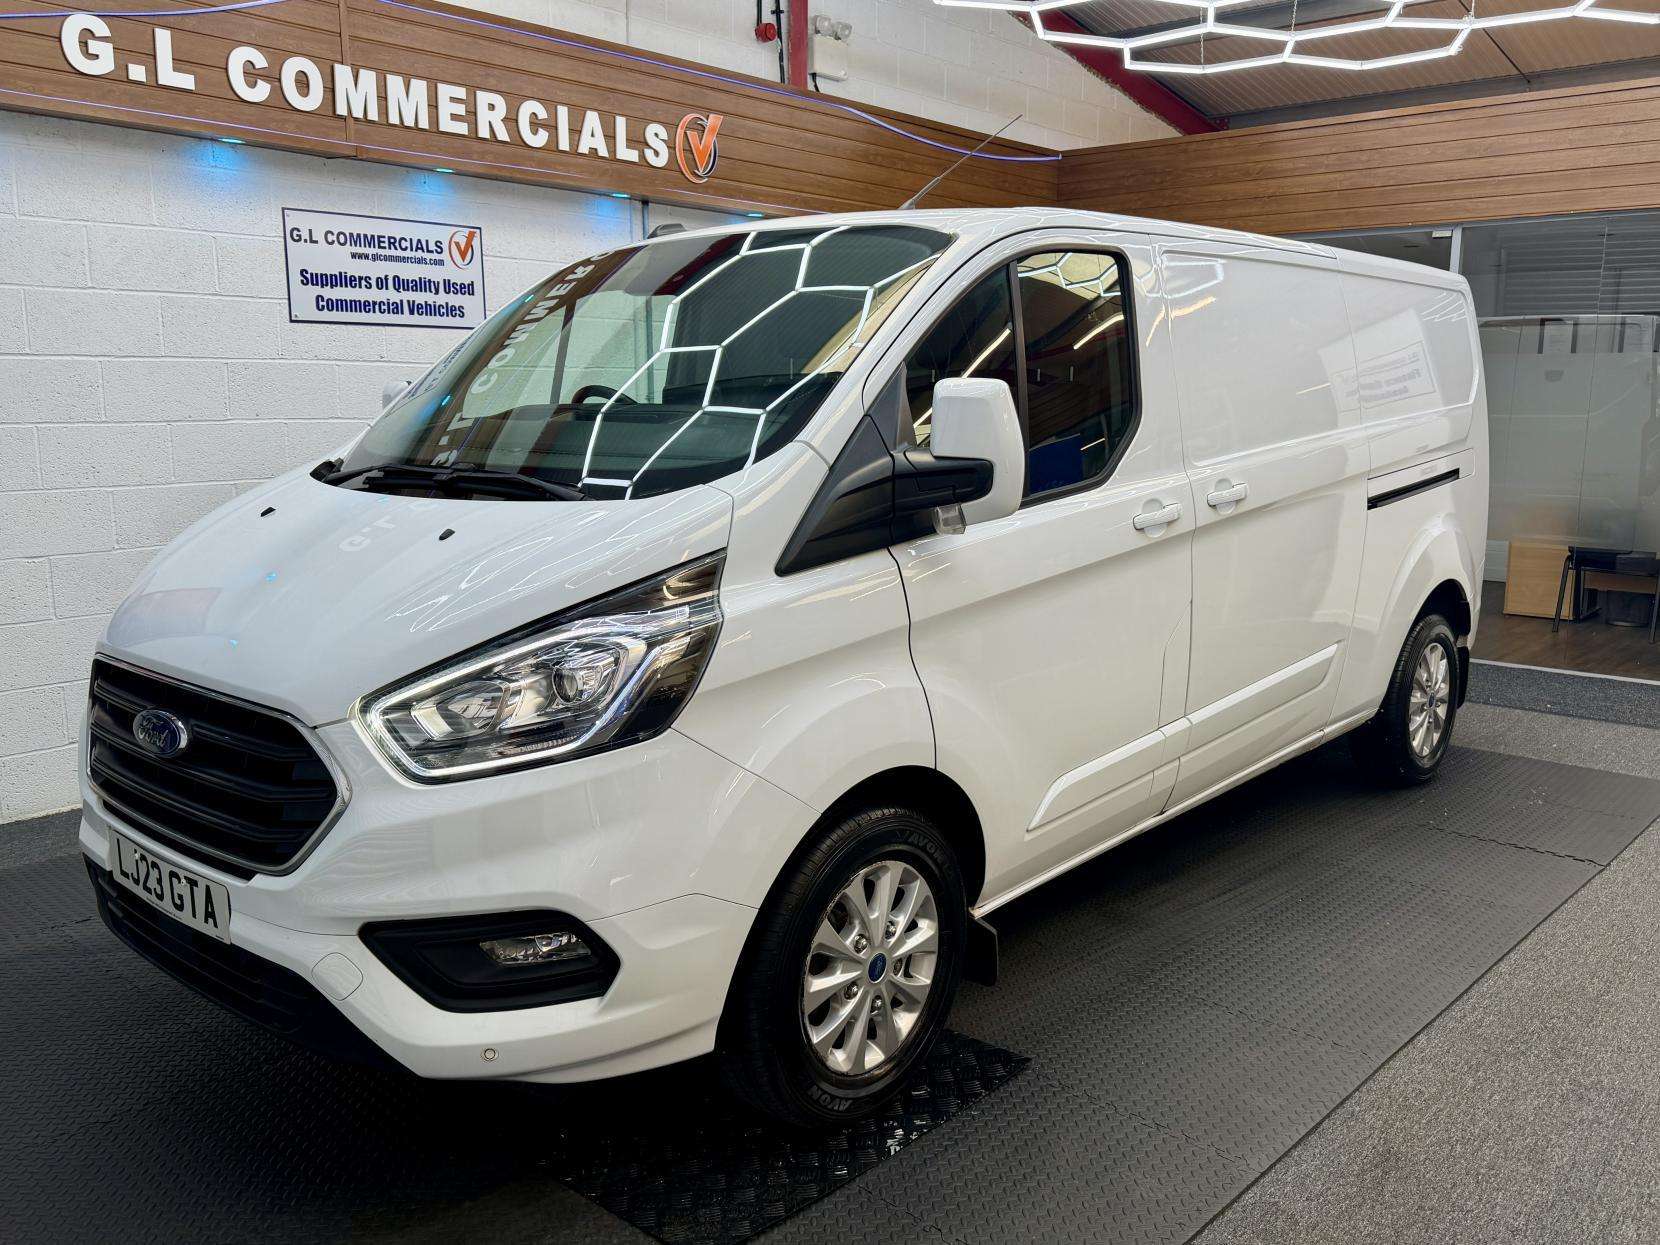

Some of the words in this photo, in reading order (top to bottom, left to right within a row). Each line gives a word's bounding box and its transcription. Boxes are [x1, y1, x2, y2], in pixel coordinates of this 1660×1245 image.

[61, 13, 196, 91] G.L
[227, 46, 670, 168] COMMERCIALS
[289, 227, 319, 245] G.L
[324, 230, 444, 255] COMMERCIALS
[350, 251, 445, 267] www.glcommercials.com
[300, 268, 373, 290] Suppliers
[375, 274, 389, 291] of
[392, 274, 440, 296] Quality
[442, 278, 475, 297] Used
[315, 294, 405, 316] Commercial
[407, 299, 465, 319] Vehicles
[138, 714, 170, 749] Ford
[116, 838, 165, 902] LJ23
[169, 869, 219, 929] GTA
